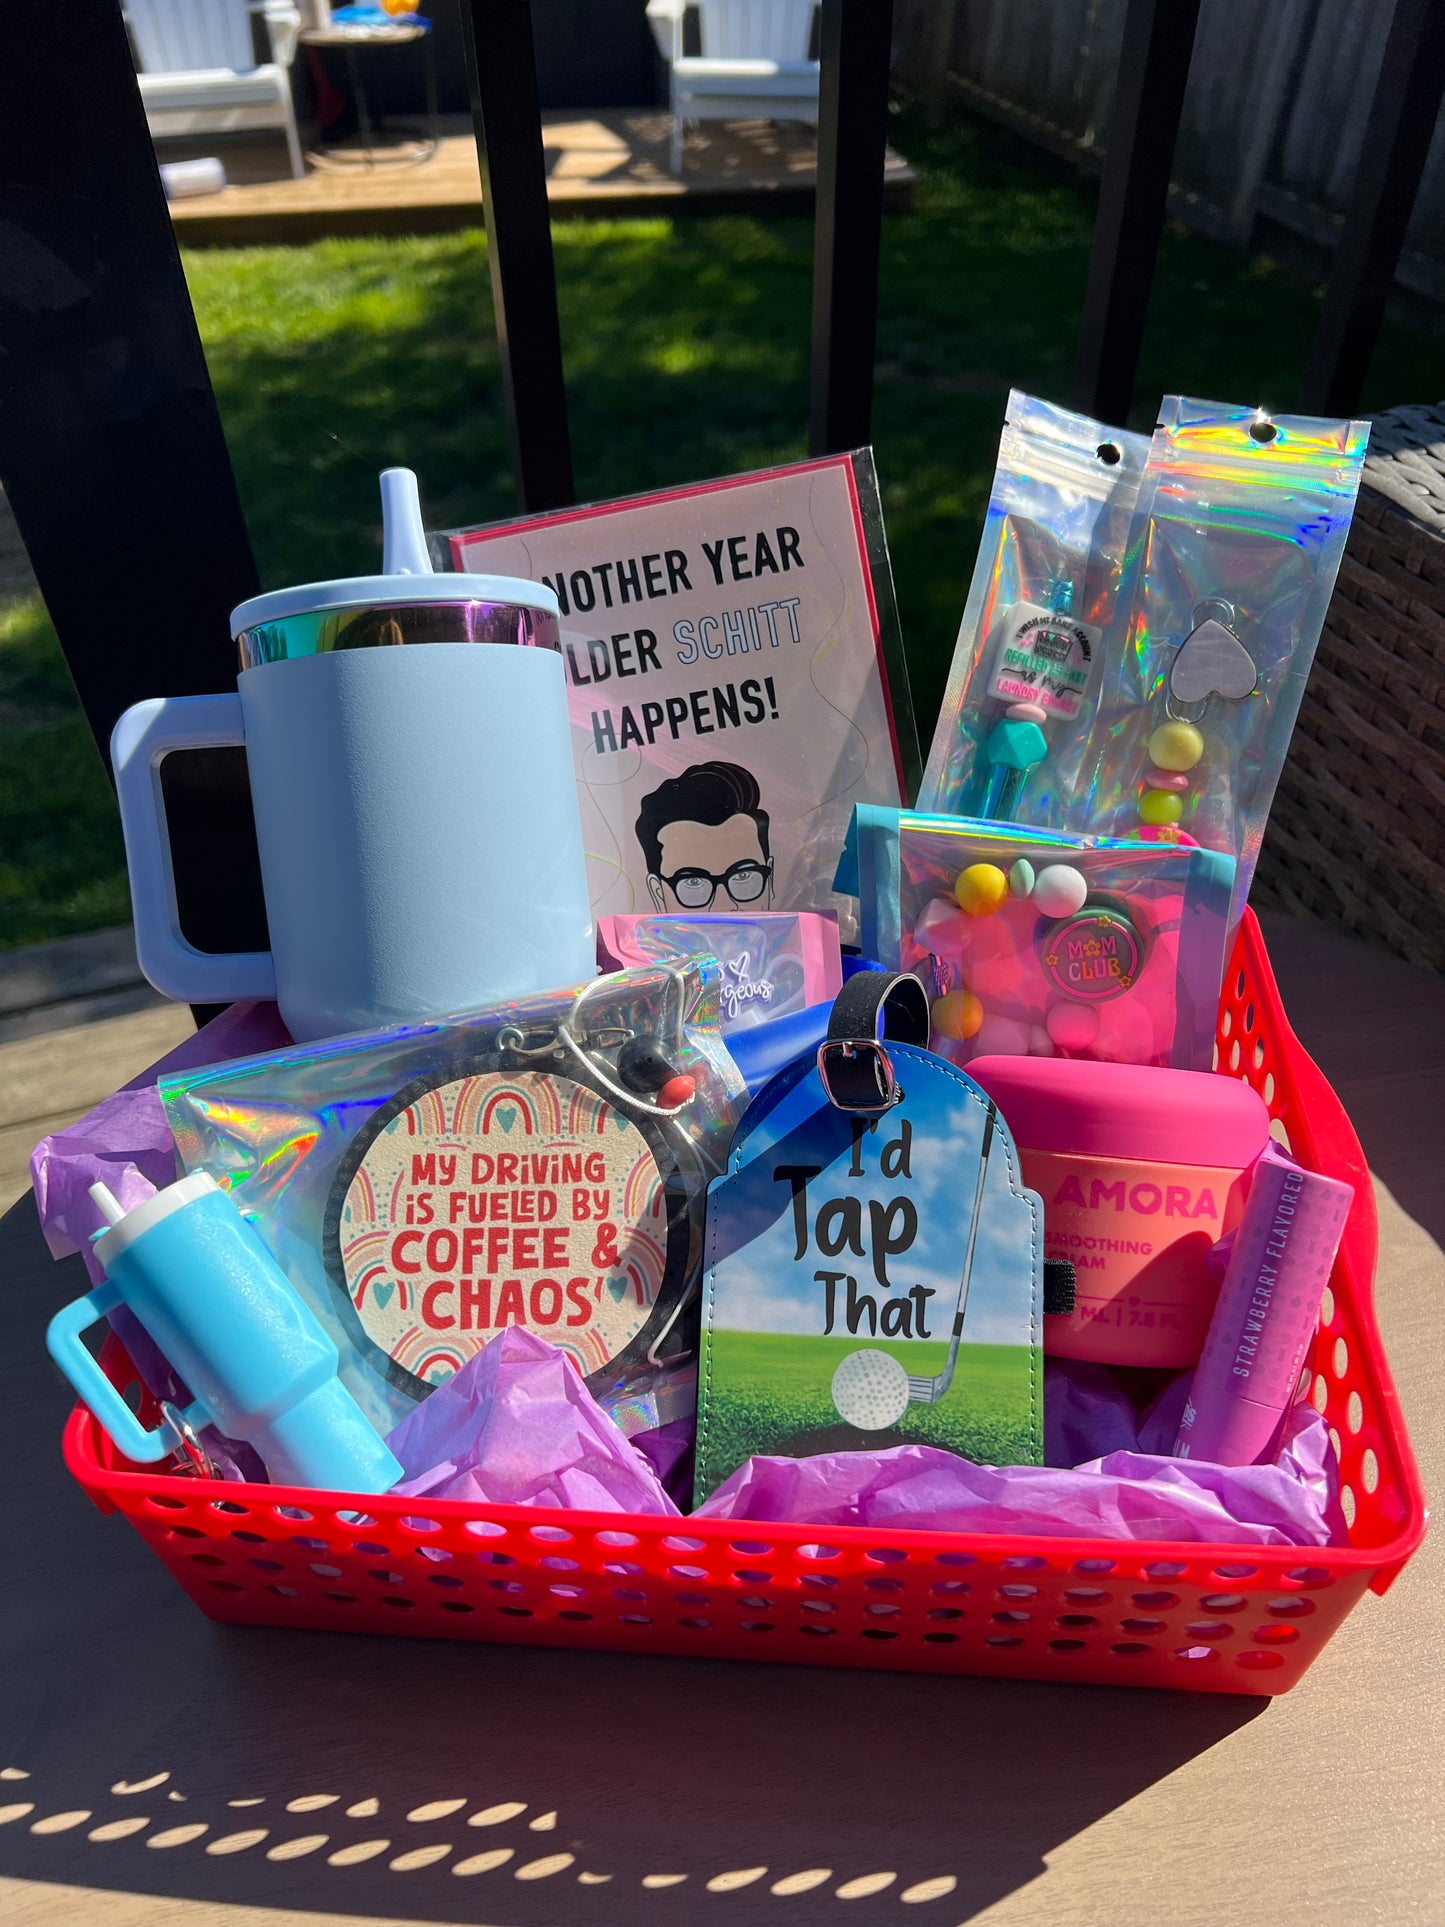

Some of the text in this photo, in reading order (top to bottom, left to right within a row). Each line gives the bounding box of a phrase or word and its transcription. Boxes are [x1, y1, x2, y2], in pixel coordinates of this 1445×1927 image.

[542, 526, 805, 616] NOTHER YEAR
[565, 629, 663, 687] LDER
[673, 598, 800, 665] SCHITT
[591, 677, 780, 754] HAPPENS!
[1068, 957, 1122, 981] CLUB
[848, 1118, 912, 1179] I'd
[449, 1190, 558, 1225] FUELED
[773, 1165, 918, 1287] Tap
[1053, 1175, 1218, 1220] AMORA
[391, 1222, 622, 1274] COFFEE &
[1044, 1232, 1152, 1256] SMOOTHING
[421, 1277, 592, 1330] CHAOS
[814, 1270, 936, 1339] That
[1232, 1172, 1304, 1378] STRAWBERRY FLAVORED
